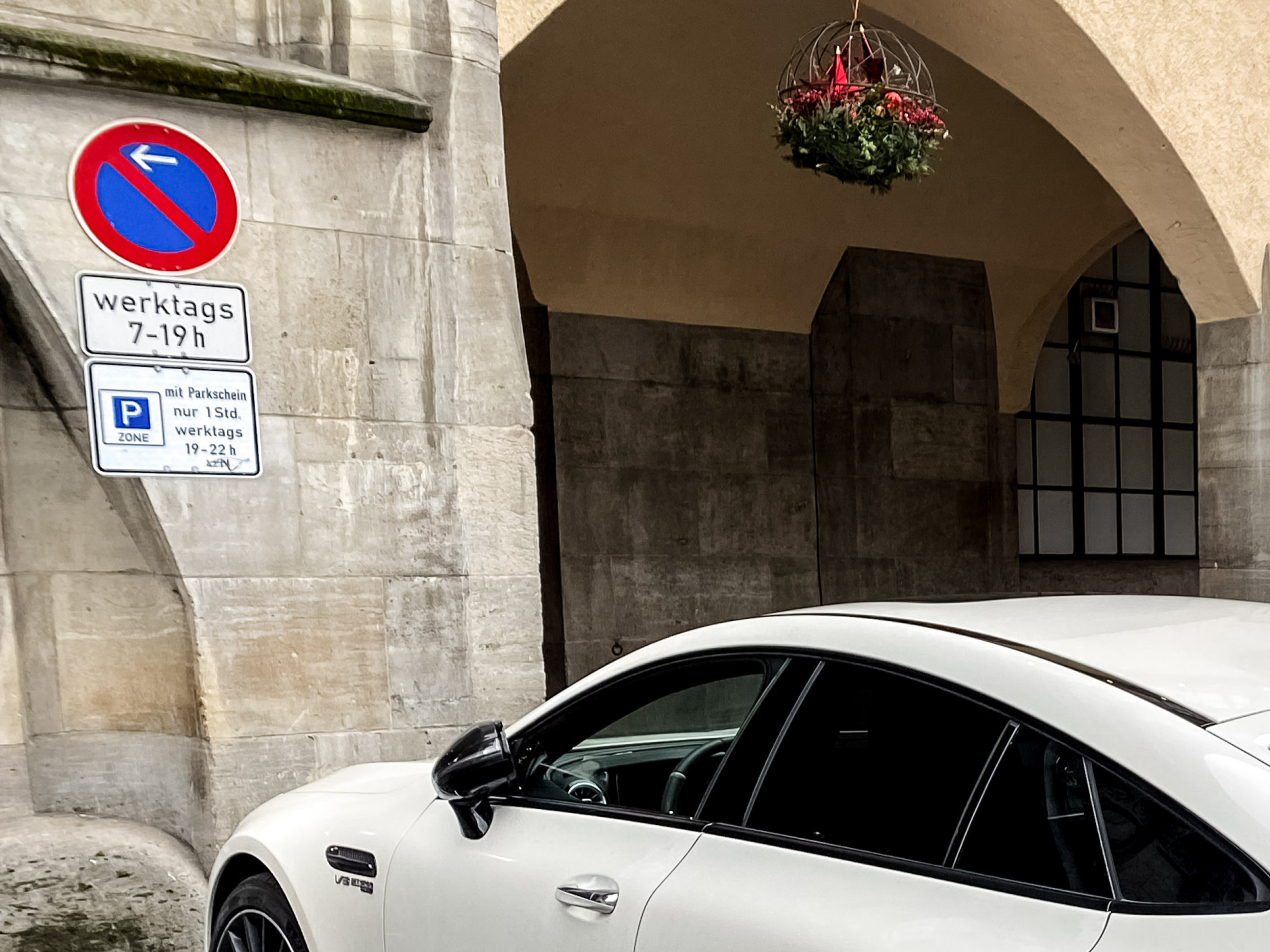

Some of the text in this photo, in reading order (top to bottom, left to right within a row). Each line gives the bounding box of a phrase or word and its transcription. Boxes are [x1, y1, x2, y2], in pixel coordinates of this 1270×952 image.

[93, 291, 235, 324] werktags
[128, 321, 187, 347] 7-19
[164, 386, 248, 401] mit Parkschein
[120, 400, 142, 427] P
[173, 406, 242, 420] nur 1 Std.
[118, 432, 150, 443] ZONE
[174, 424, 244, 440] werktags
[185, 442, 237, 456] 19-22 h
